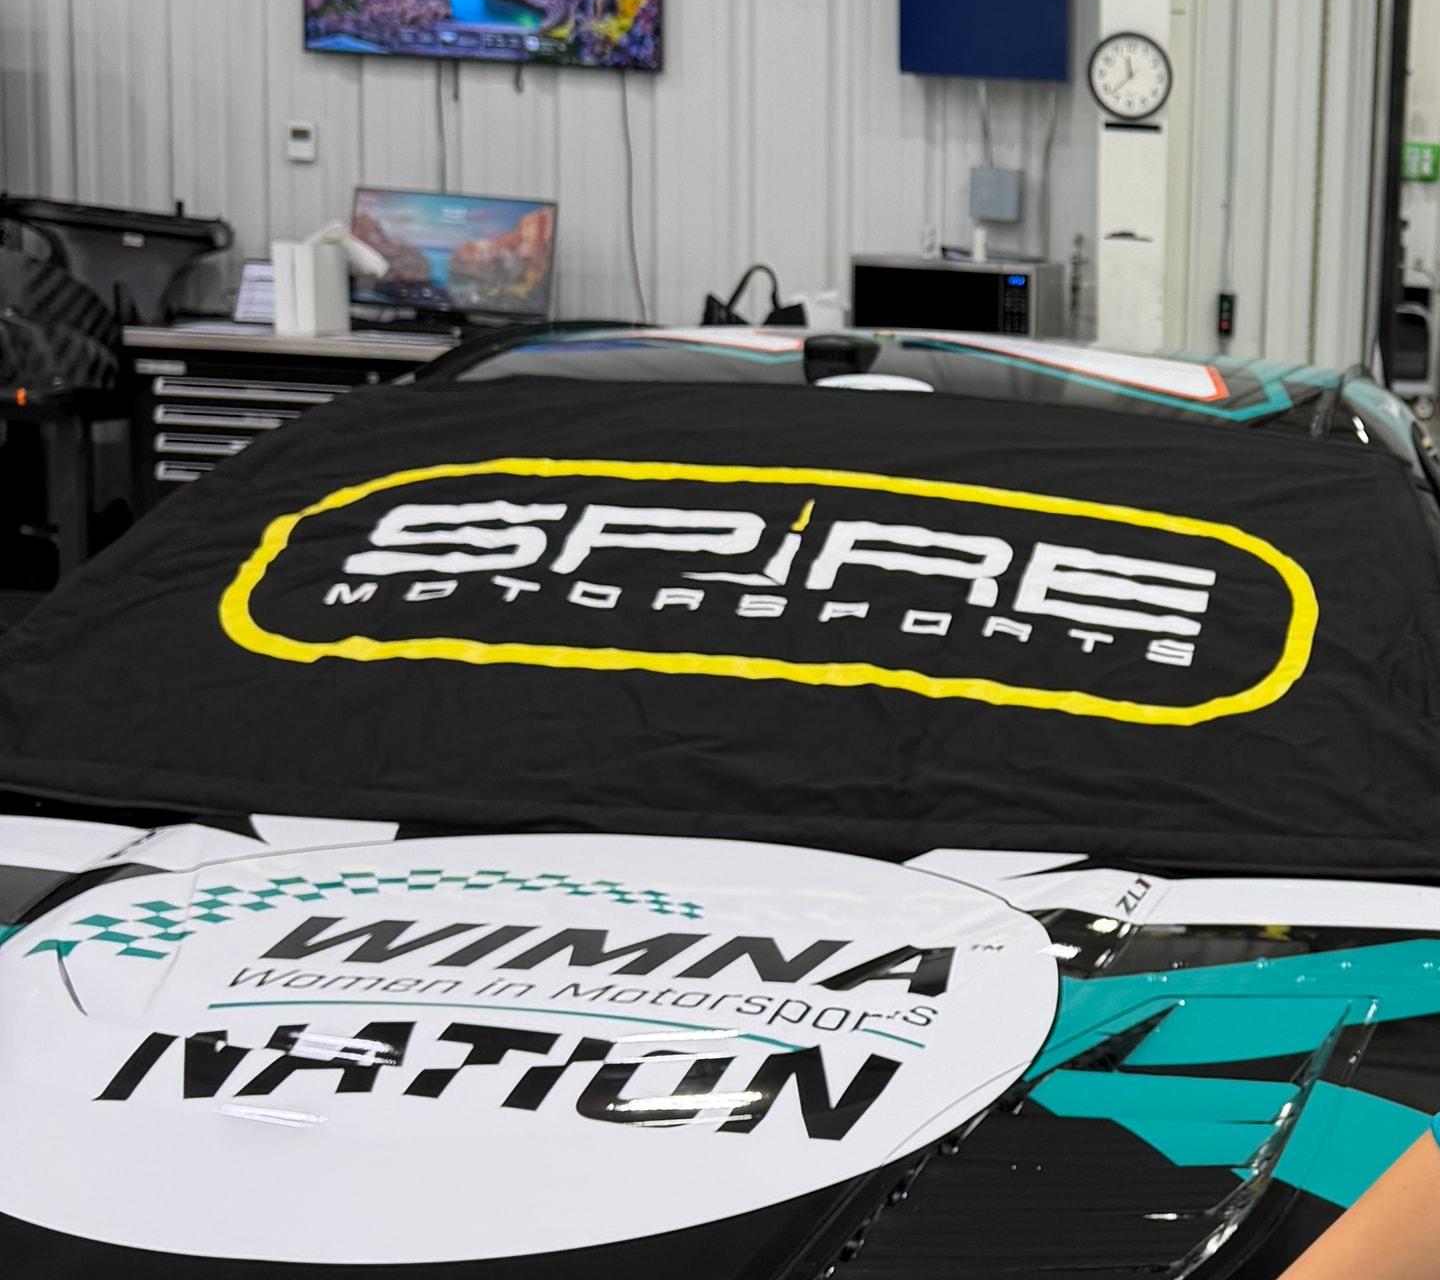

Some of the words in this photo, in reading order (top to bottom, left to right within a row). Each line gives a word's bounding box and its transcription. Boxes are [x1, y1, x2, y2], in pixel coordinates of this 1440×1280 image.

[342, 500, 1216, 638] SPIRE
[323, 576, 1196, 668] MOTORSPORTS
[228, 967, 463, 996] Women
[472, 972, 537, 999] in
[258, 915, 957, 998] WIMNA
[92, 1021, 904, 1141] NATION
